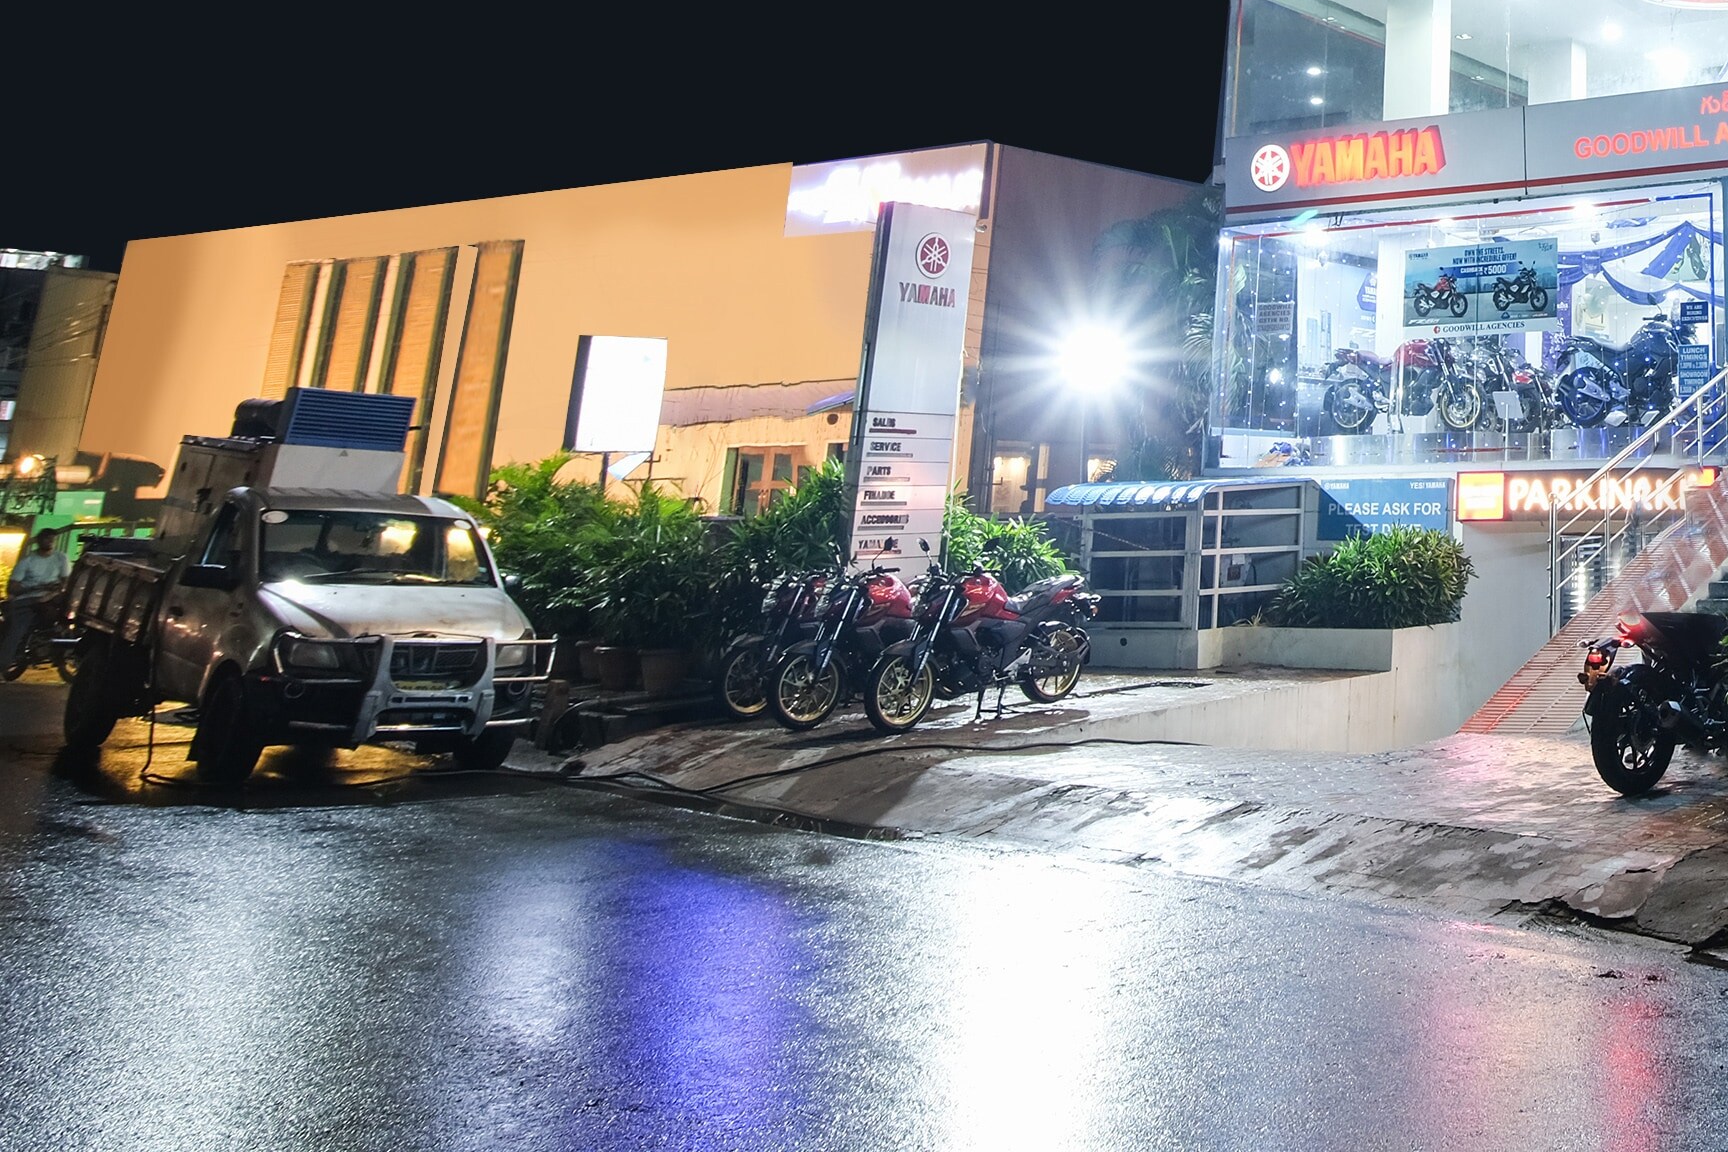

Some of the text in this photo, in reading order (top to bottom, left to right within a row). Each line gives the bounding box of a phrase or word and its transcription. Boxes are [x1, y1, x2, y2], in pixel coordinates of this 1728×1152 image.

[1573, 125, 1709, 159] GOODWILL
[1290, 125, 1446, 188] YAMAHA
[899, 281, 955, 308] YAMAHA
[1442, 321, 1525, 333] GOODWILL AGENCIES
[870, 442, 902, 452] SERVICE
[866, 466, 892, 476] PARTS
[1328, 502, 1441, 515] PLEASE ASK FOR
[1345, 523, 1378, 536] TEST
